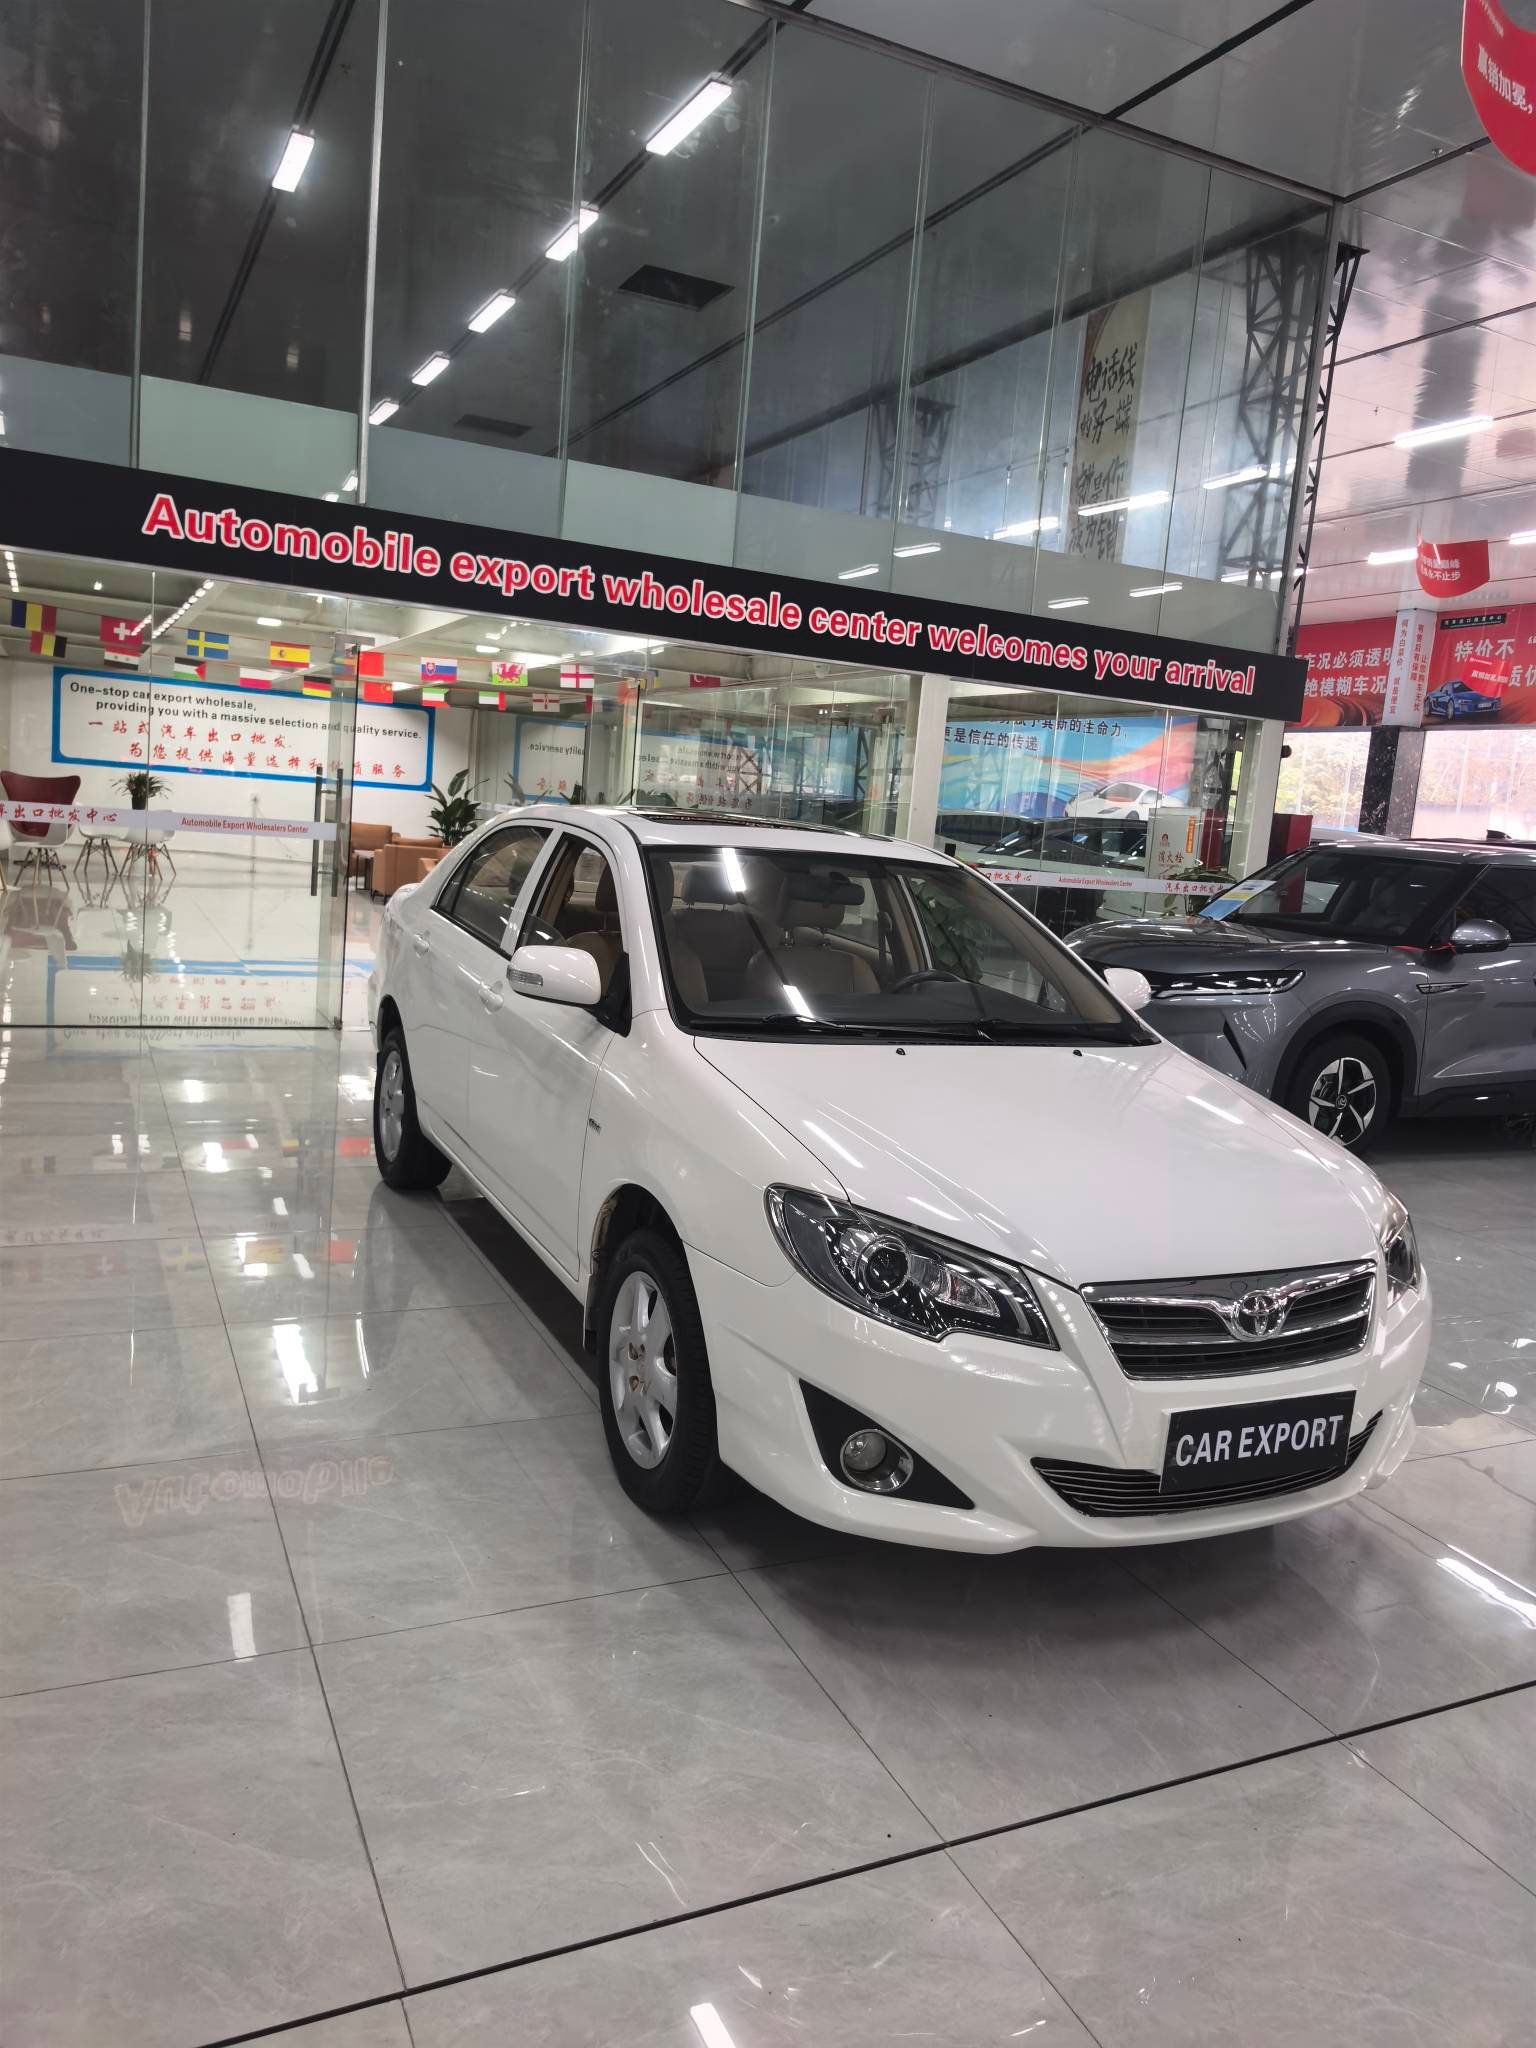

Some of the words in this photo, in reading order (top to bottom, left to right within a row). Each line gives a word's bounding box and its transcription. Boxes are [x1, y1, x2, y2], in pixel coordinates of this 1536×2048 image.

[142, 493, 440, 576] Automobile
[450, 551, 595, 600] export
[603, 571, 802, 630] wholesale
[809, 607, 922, 647] center
[928, 624, 1087, 670] welcomes
[1094, 649, 1161, 680] your
[1165, 658, 1256, 695] arrival
[70, 681, 130, 699] One-stop
[132, 690, 150, 700] car
[153, 694, 193, 704] export
[195, 696, 256, 711] wholesale,
[96, 700, 154, 716] providing
[158, 706, 179, 717] you
[183, 708, 208, 719] with
[211, 712, 217, 720] a
[220, 713, 266, 724] massive
[269, 716, 318, 730] selection
[321, 720, 341, 731] and
[382, 727, 422, 739] service.
[181, 816, 222, 828] Automobile
[222, 820, 245, 830] Export
[246, 822, 287, 833] Wholesalers
[287, 824, 309, 833] Center
[1176, 1429, 1232, 1467] CAR
[1237, 1414, 1344, 1459] EXPORT
